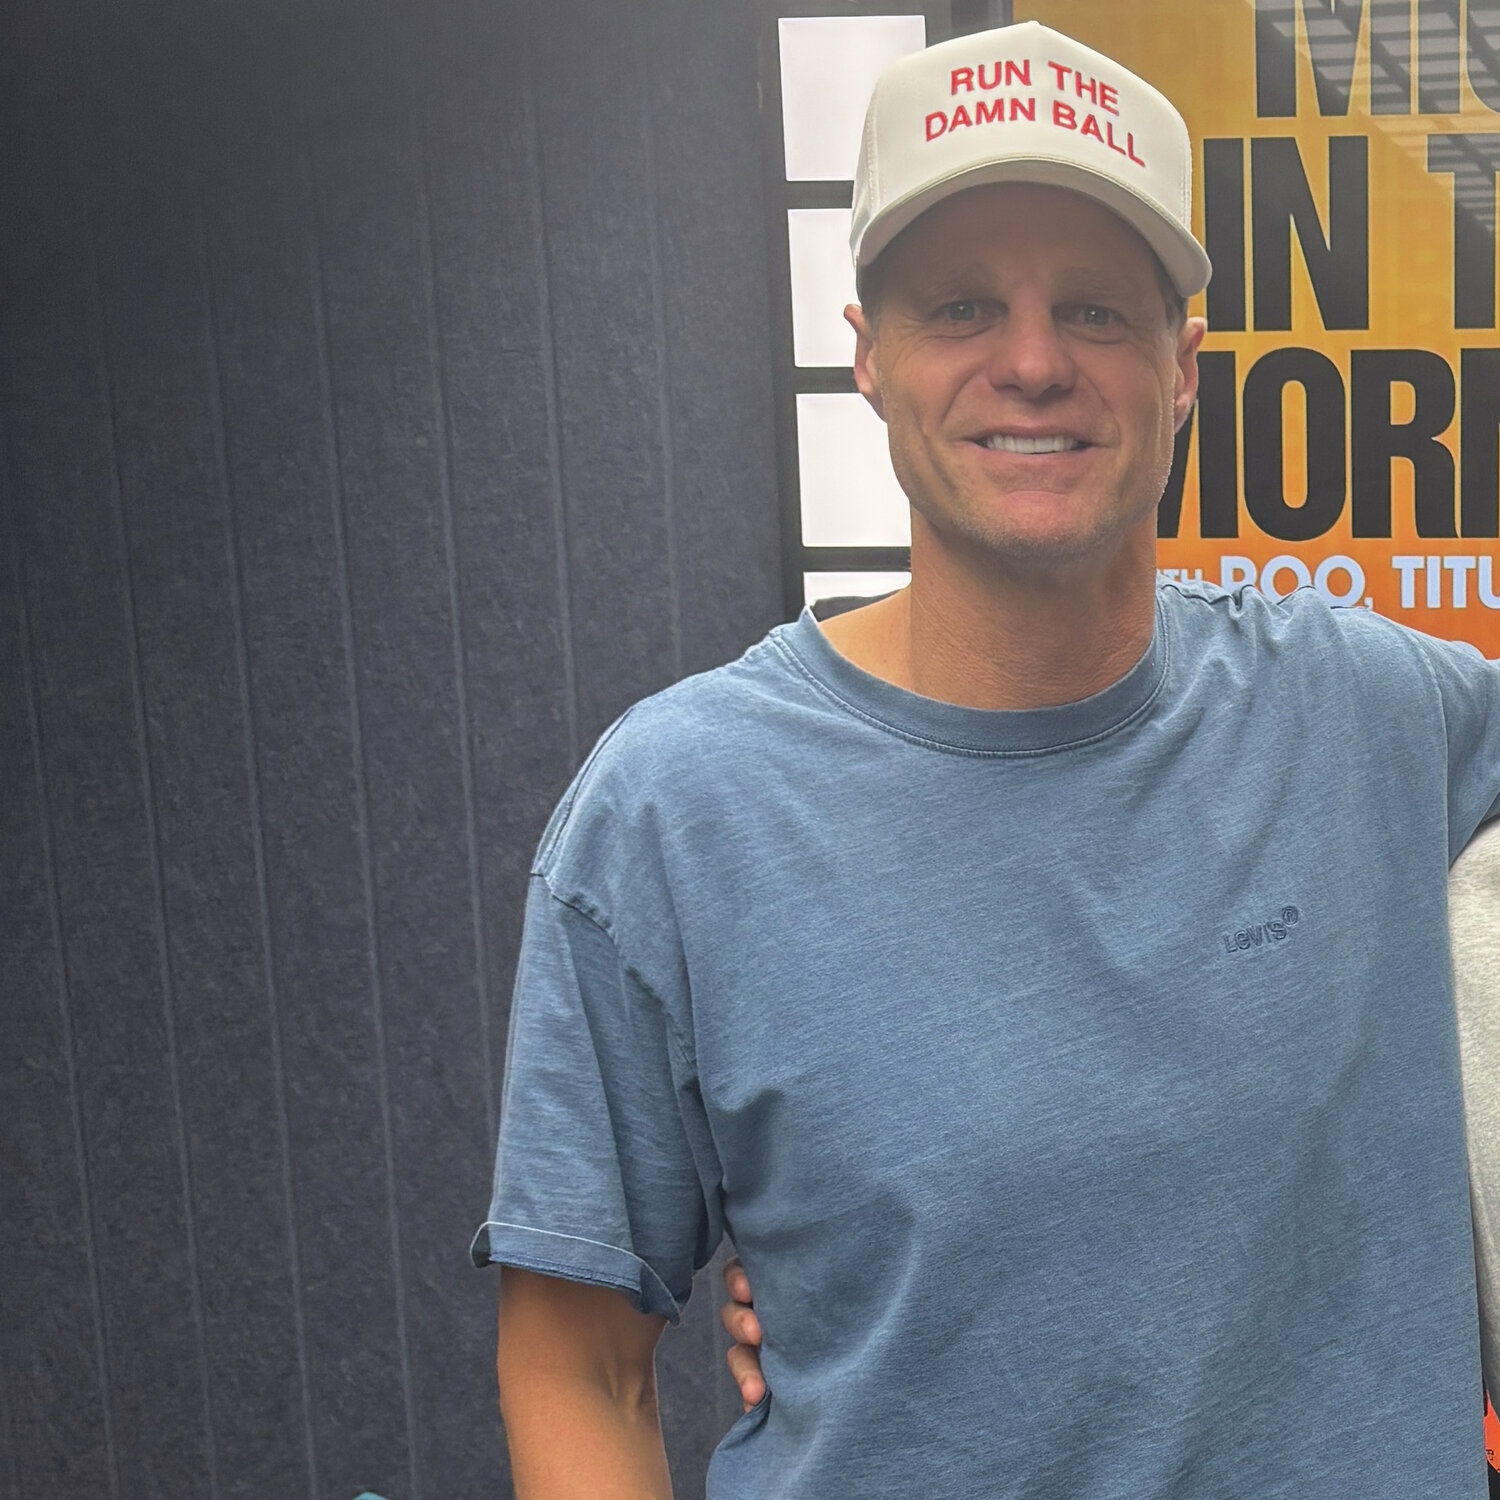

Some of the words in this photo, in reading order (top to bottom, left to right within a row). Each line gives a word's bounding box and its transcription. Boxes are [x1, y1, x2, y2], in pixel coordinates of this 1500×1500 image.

[951, 59, 1032, 96] RUN
[1047, 60, 1120, 117] THE
[925, 97, 1036, 143] DAMN
[1052, 99, 1146, 168] BALL
[1203, 135, 1370, 332] IN
